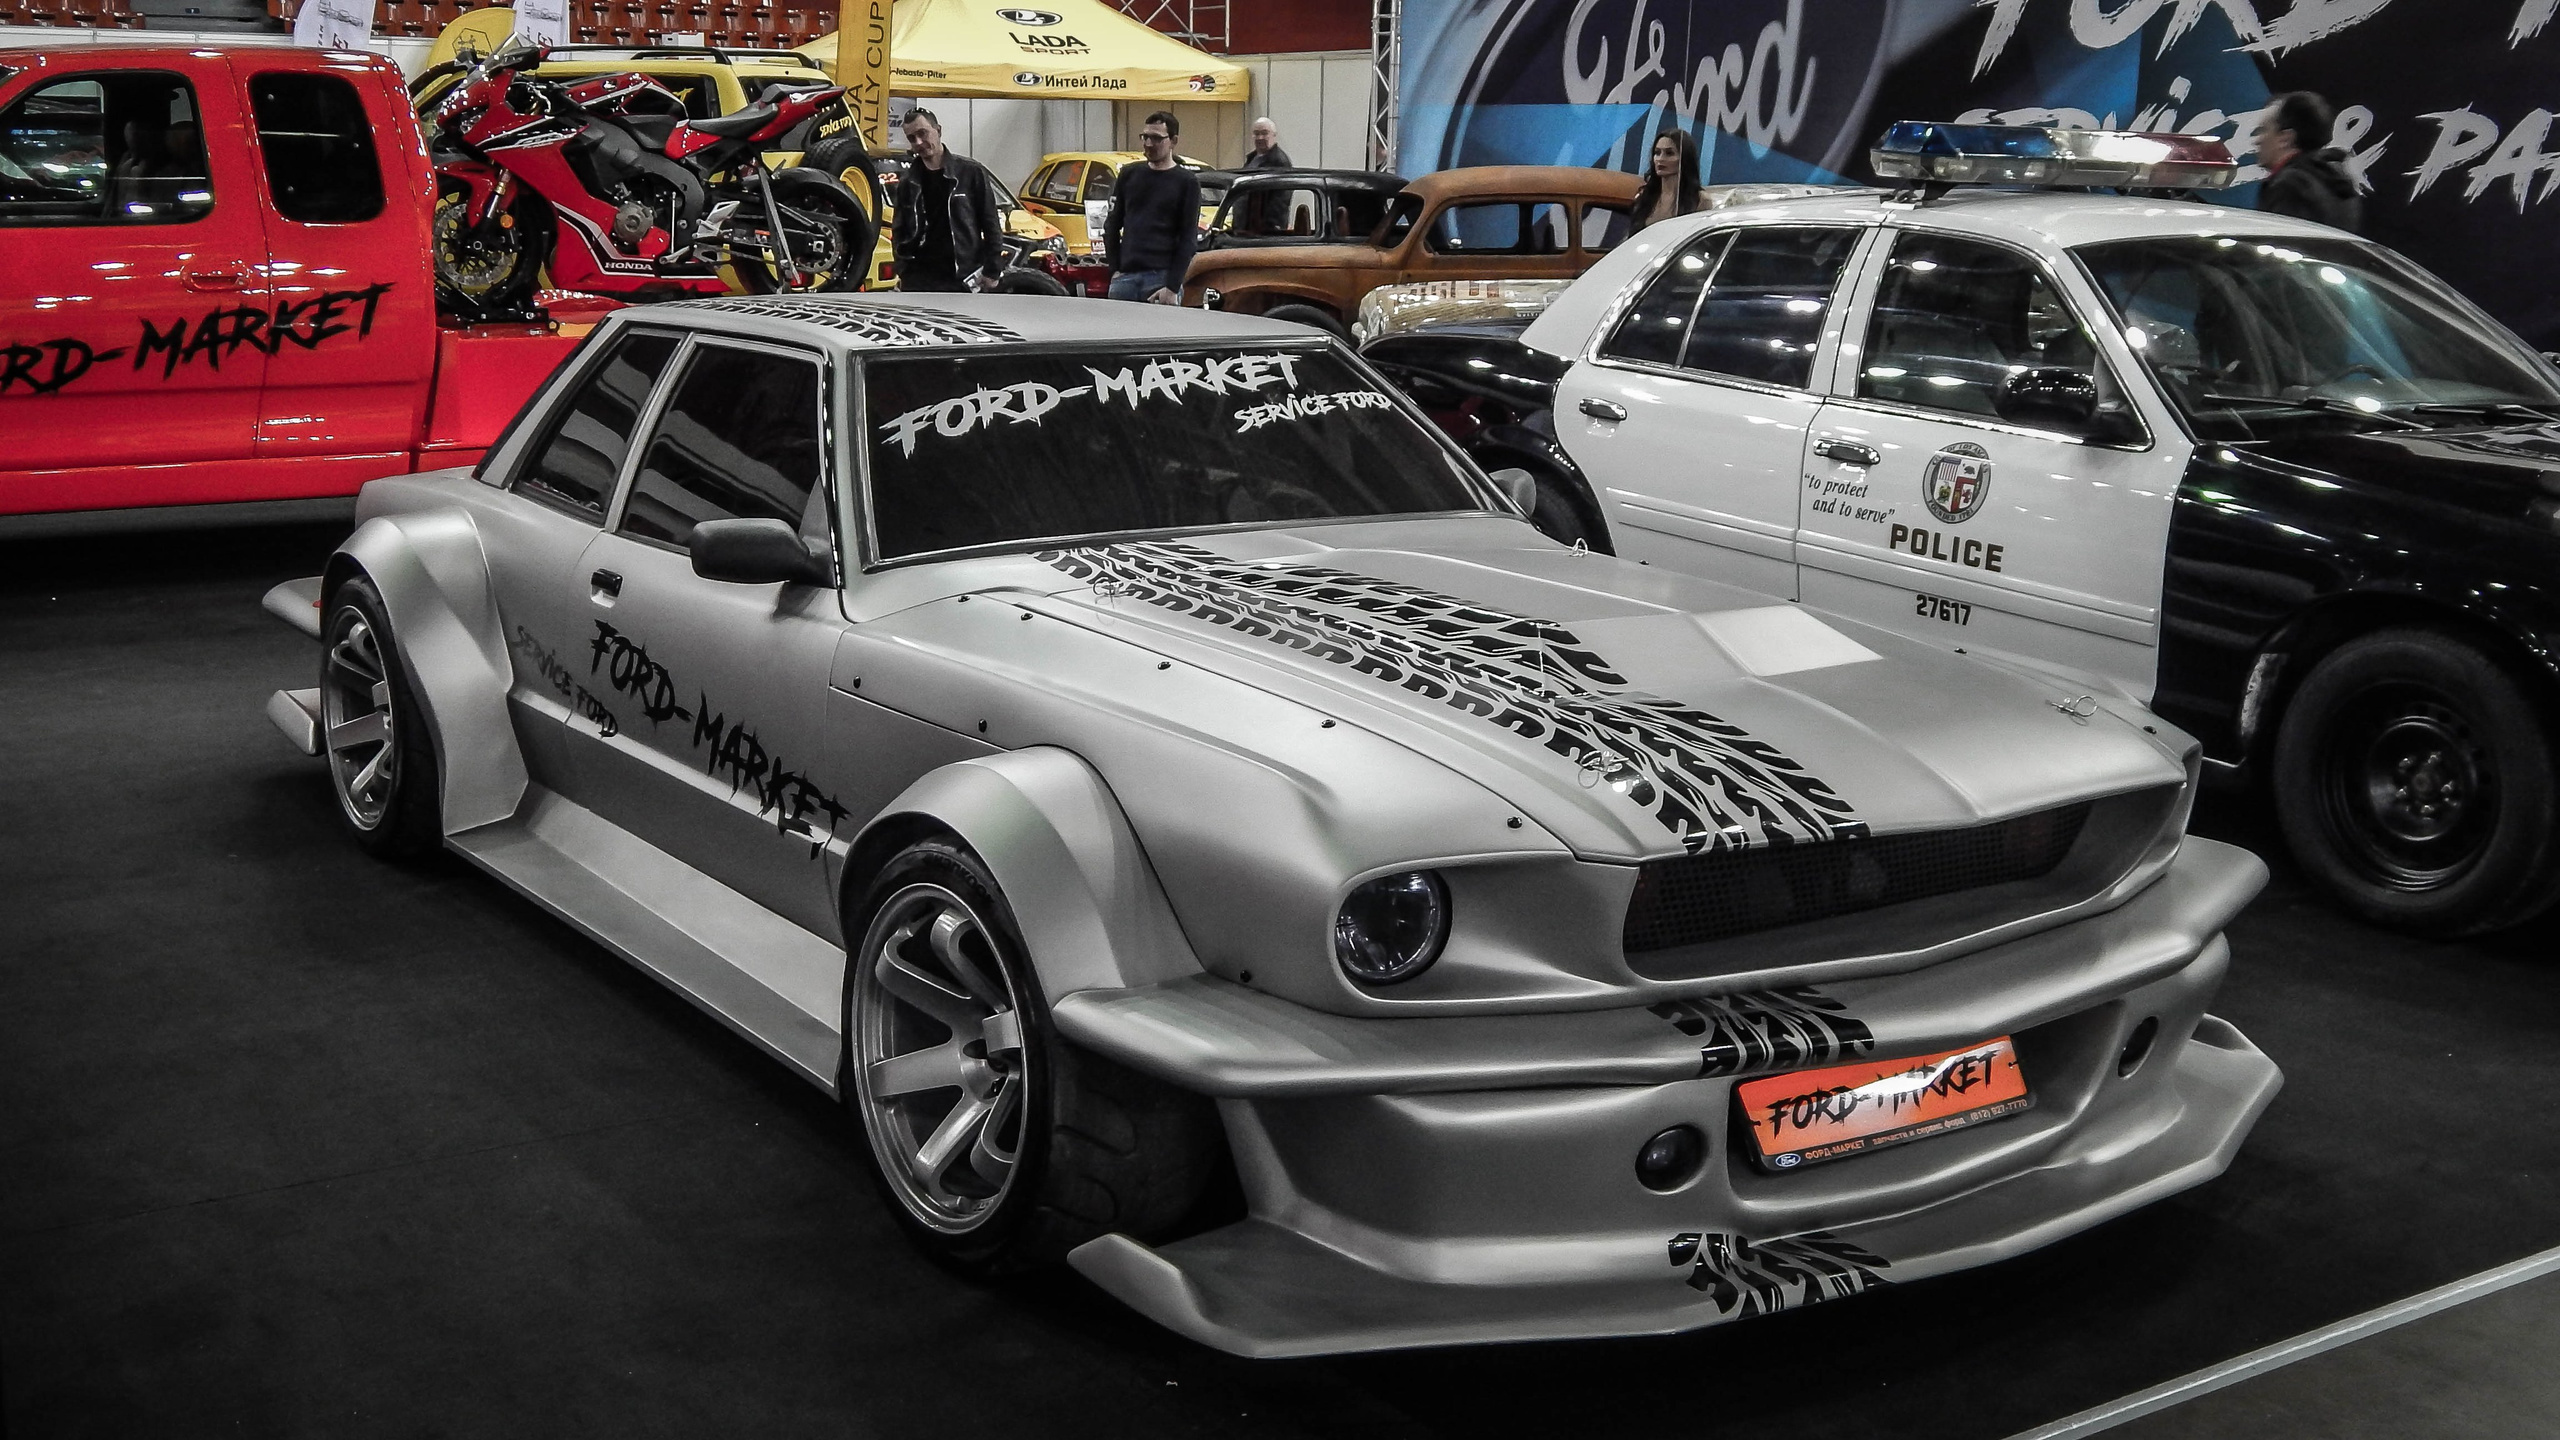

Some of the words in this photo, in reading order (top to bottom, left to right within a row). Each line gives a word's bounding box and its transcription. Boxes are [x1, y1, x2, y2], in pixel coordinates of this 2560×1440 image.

[866, 1, 885, 69] CUP
[1008, 32, 1087, 47] LADA
[1020, 46, 1091, 55] SPORT
[1045, 75, 1088, 88] Интей
[1091, 75, 1127, 90] Лада
[2401, 102, 2560, 214] PA
[604, 261, 653, 271] HONDA
[878, 353, 1302, 460] FORD-MARKET
[1330, 388, 1392, 412] FORD
[1822, 481, 1869, 498] protect
[1812, 498, 1837, 514] and
[1839, 501, 1852, 517] to
[1889, 523, 2004, 573] POLICE
[1916, 594, 1972, 626] 27617
[576, 684, 619, 739] FORD
[590, 619, 853, 862] FORD-MARKET
[1805, 1139, 1866, 1160] ФОРД-МАРКЕТ
